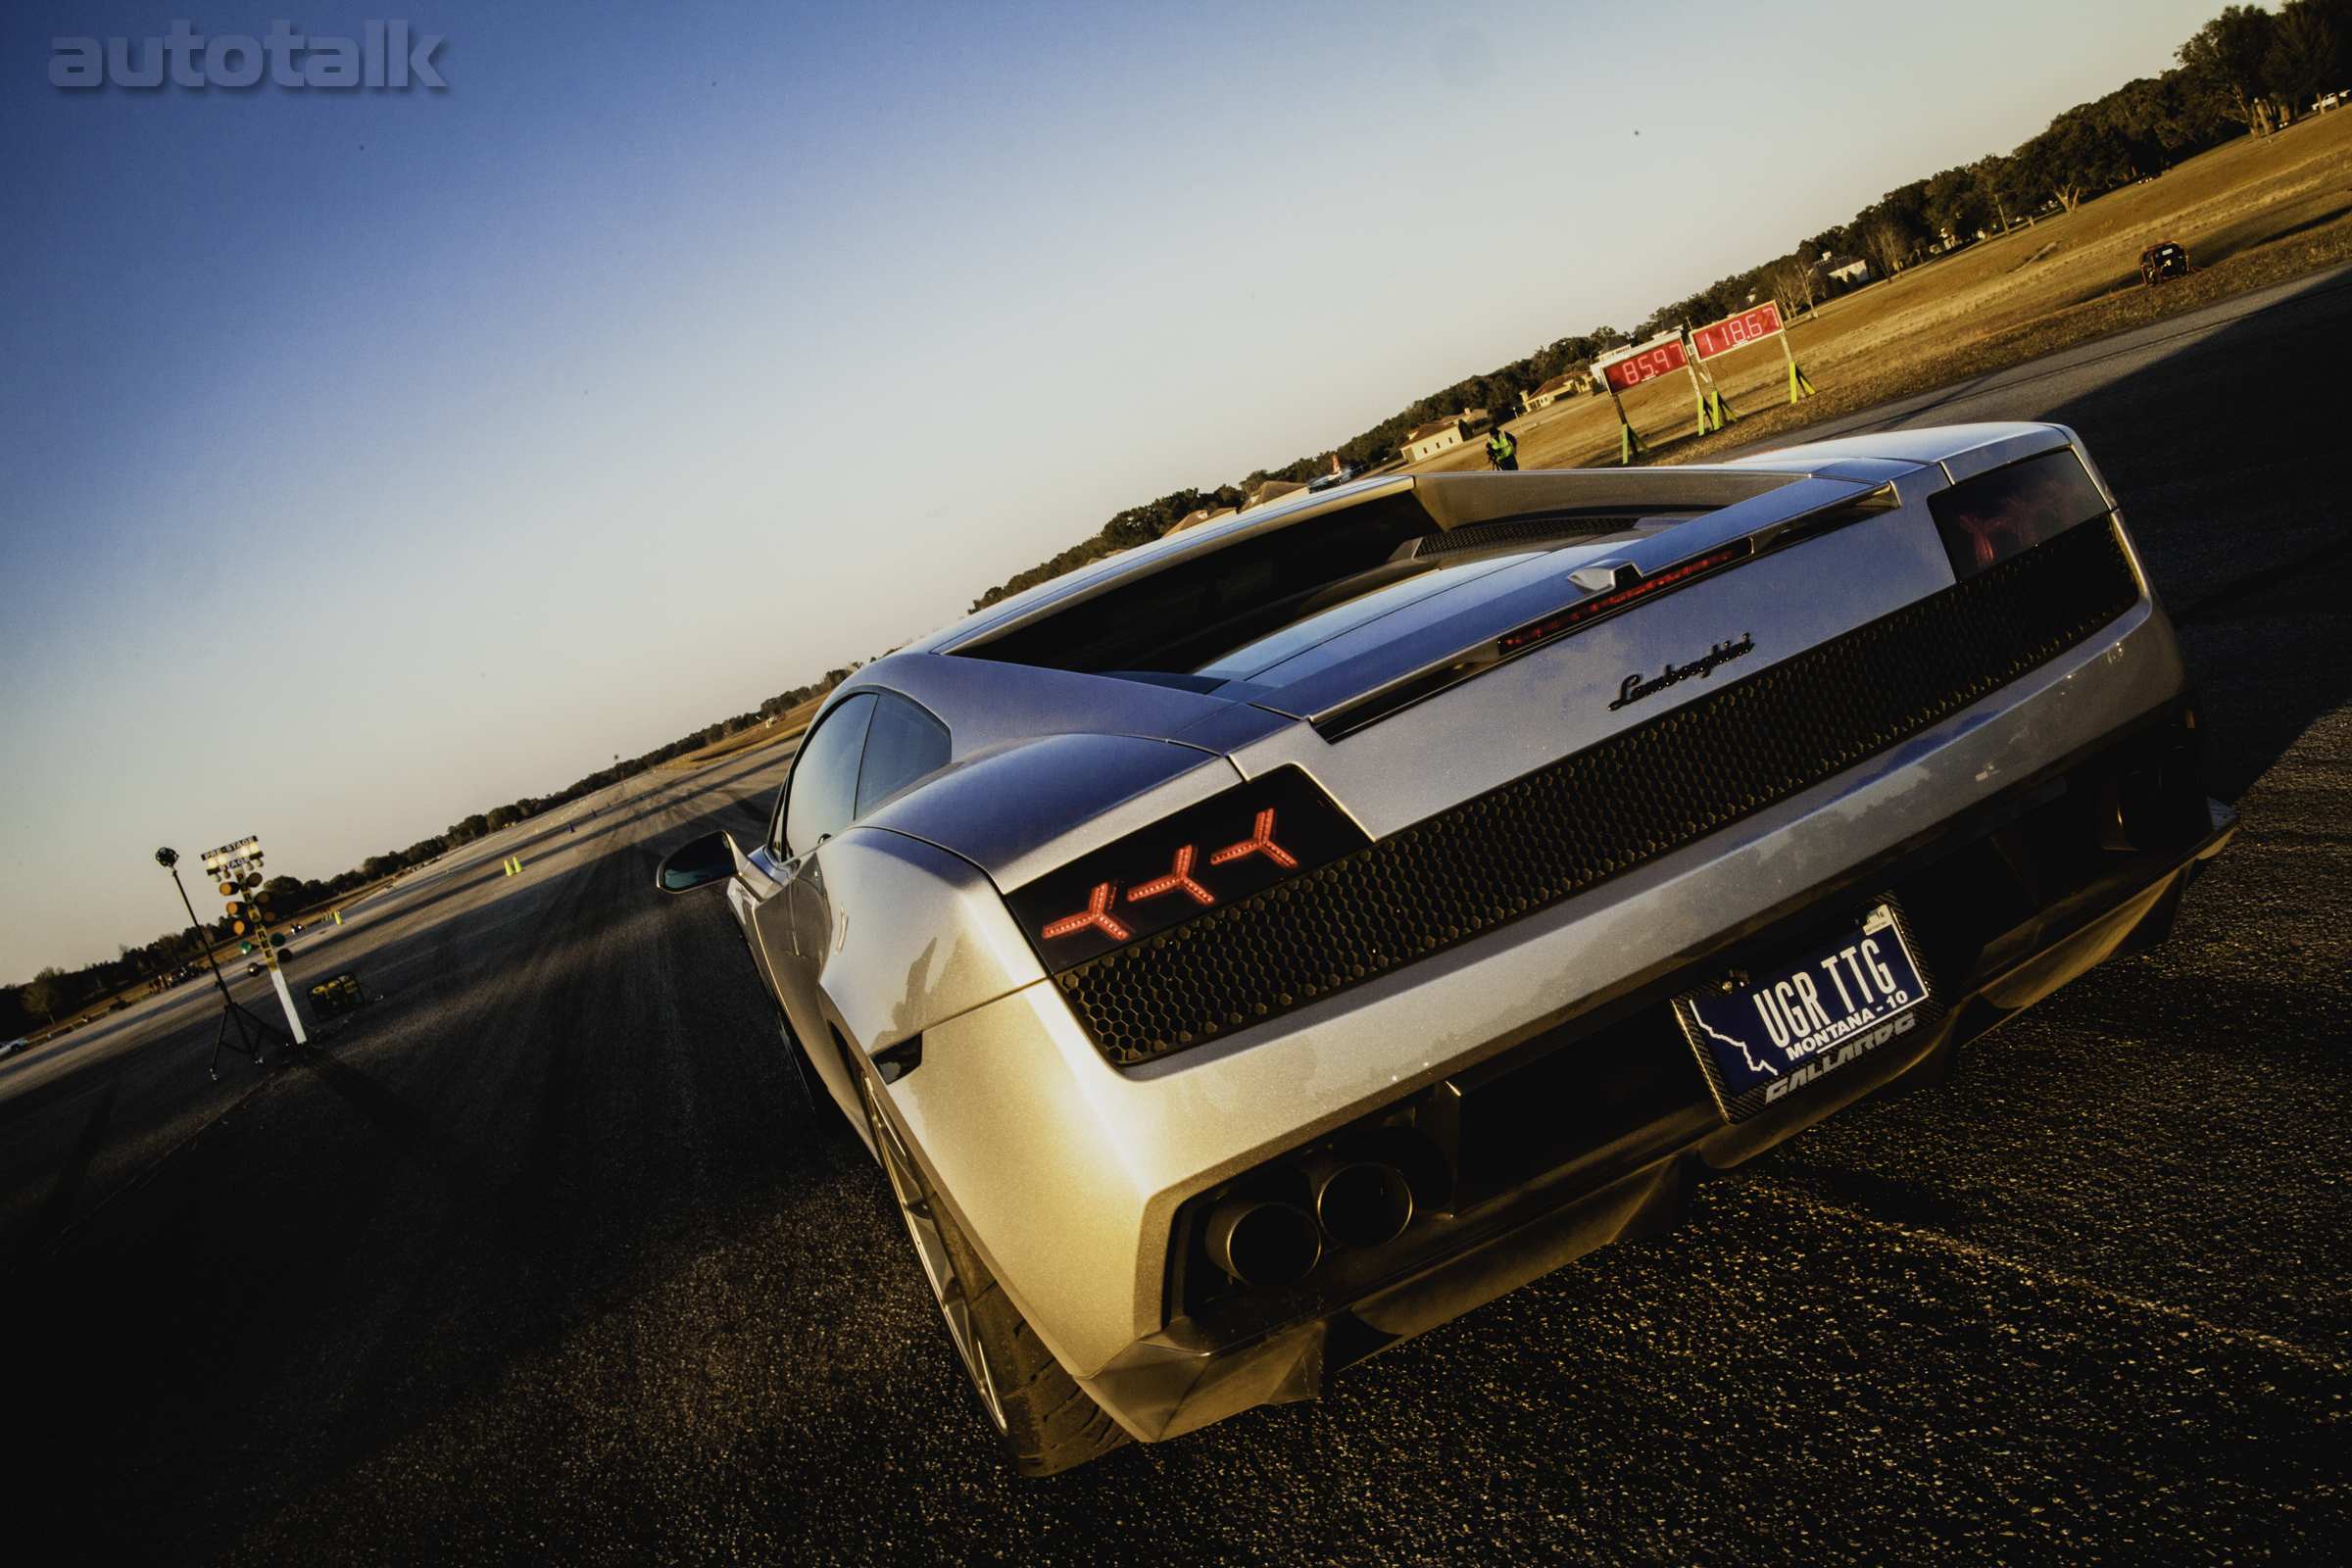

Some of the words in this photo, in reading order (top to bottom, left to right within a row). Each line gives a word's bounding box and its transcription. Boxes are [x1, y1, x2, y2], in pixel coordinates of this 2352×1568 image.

[1622, 343, 1687, 384] 85.97
[1608, 632, 1755, 711] Lamborghini
[204, 837, 255, 859] PRE-STAGE
[218, 857, 251, 872] STAGE
[1752, 971, 1831, 1049] UGR
[1821, 939, 1897, 1014] TTG
[1786, 1007, 1876, 1061] MONTANA
